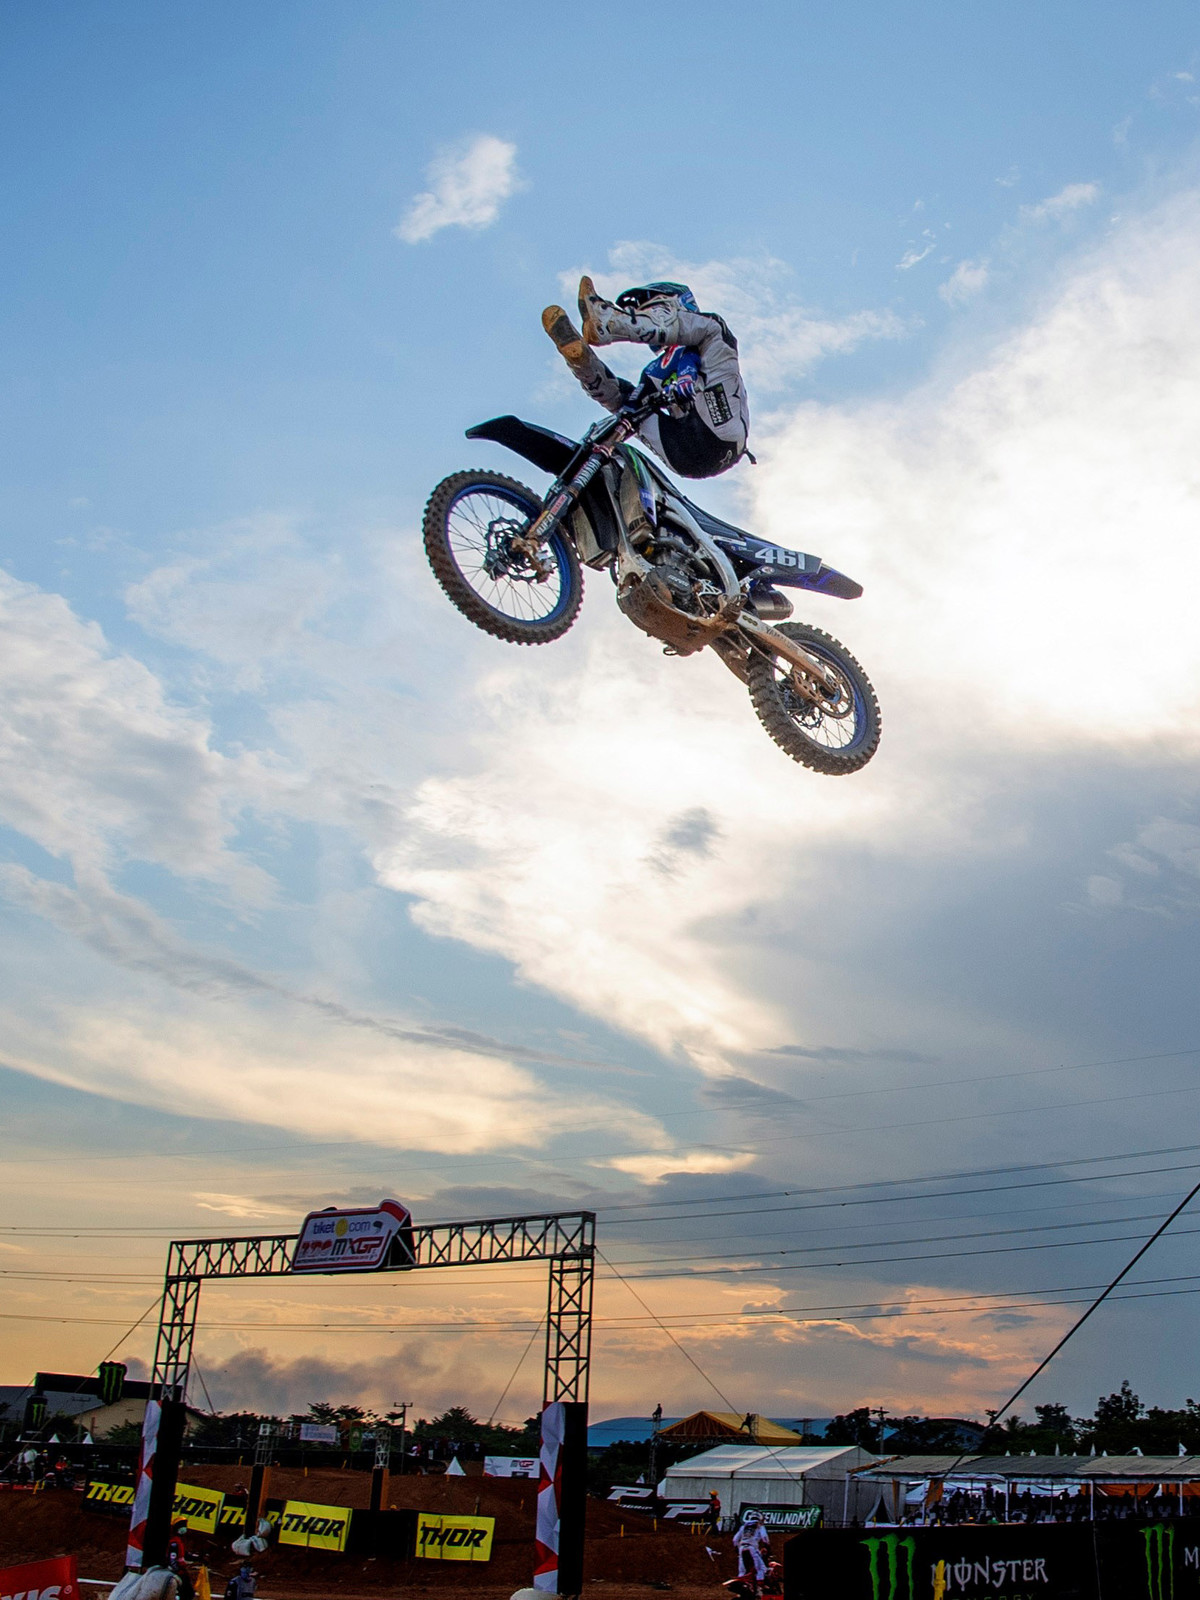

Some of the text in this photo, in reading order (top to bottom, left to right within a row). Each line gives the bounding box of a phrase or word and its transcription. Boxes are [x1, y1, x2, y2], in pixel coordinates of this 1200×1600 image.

[755, 547, 806, 571] 461
[283, 1512, 346, 1538] THOR
[419, 1525, 488, 1548] THOR
